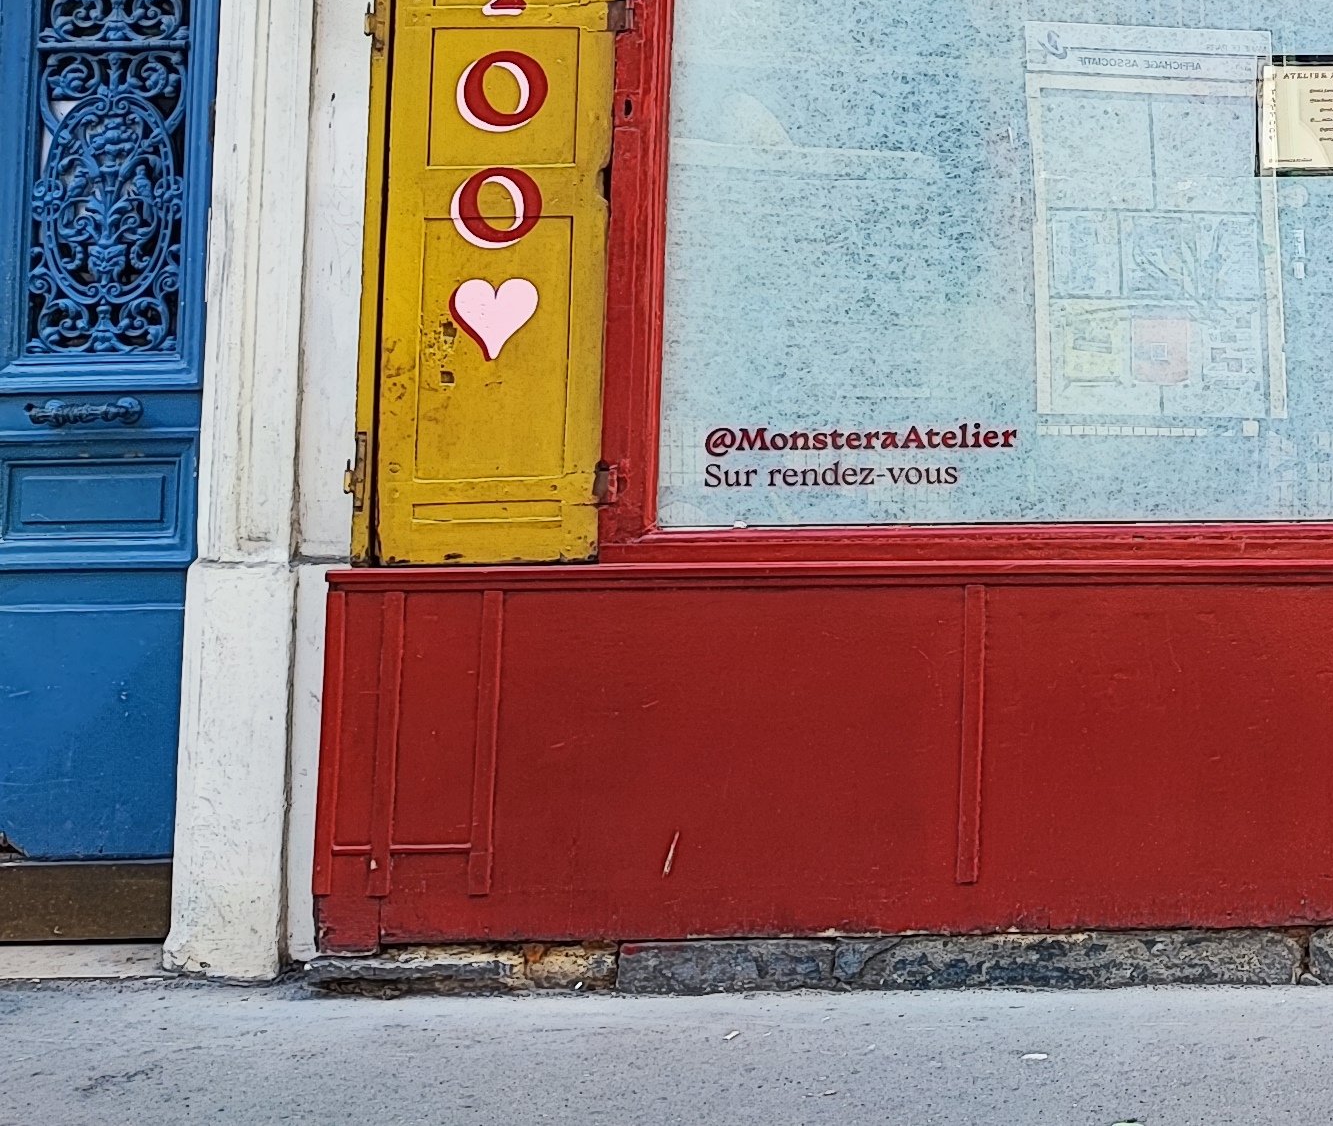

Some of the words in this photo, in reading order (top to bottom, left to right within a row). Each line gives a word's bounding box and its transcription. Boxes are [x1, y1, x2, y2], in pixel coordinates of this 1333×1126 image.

[704, 423, 1018, 457] @MonsteraAtelier
[704, 463, 757, 488] Sur
[768, 461, 959, 487] rendez-vous
